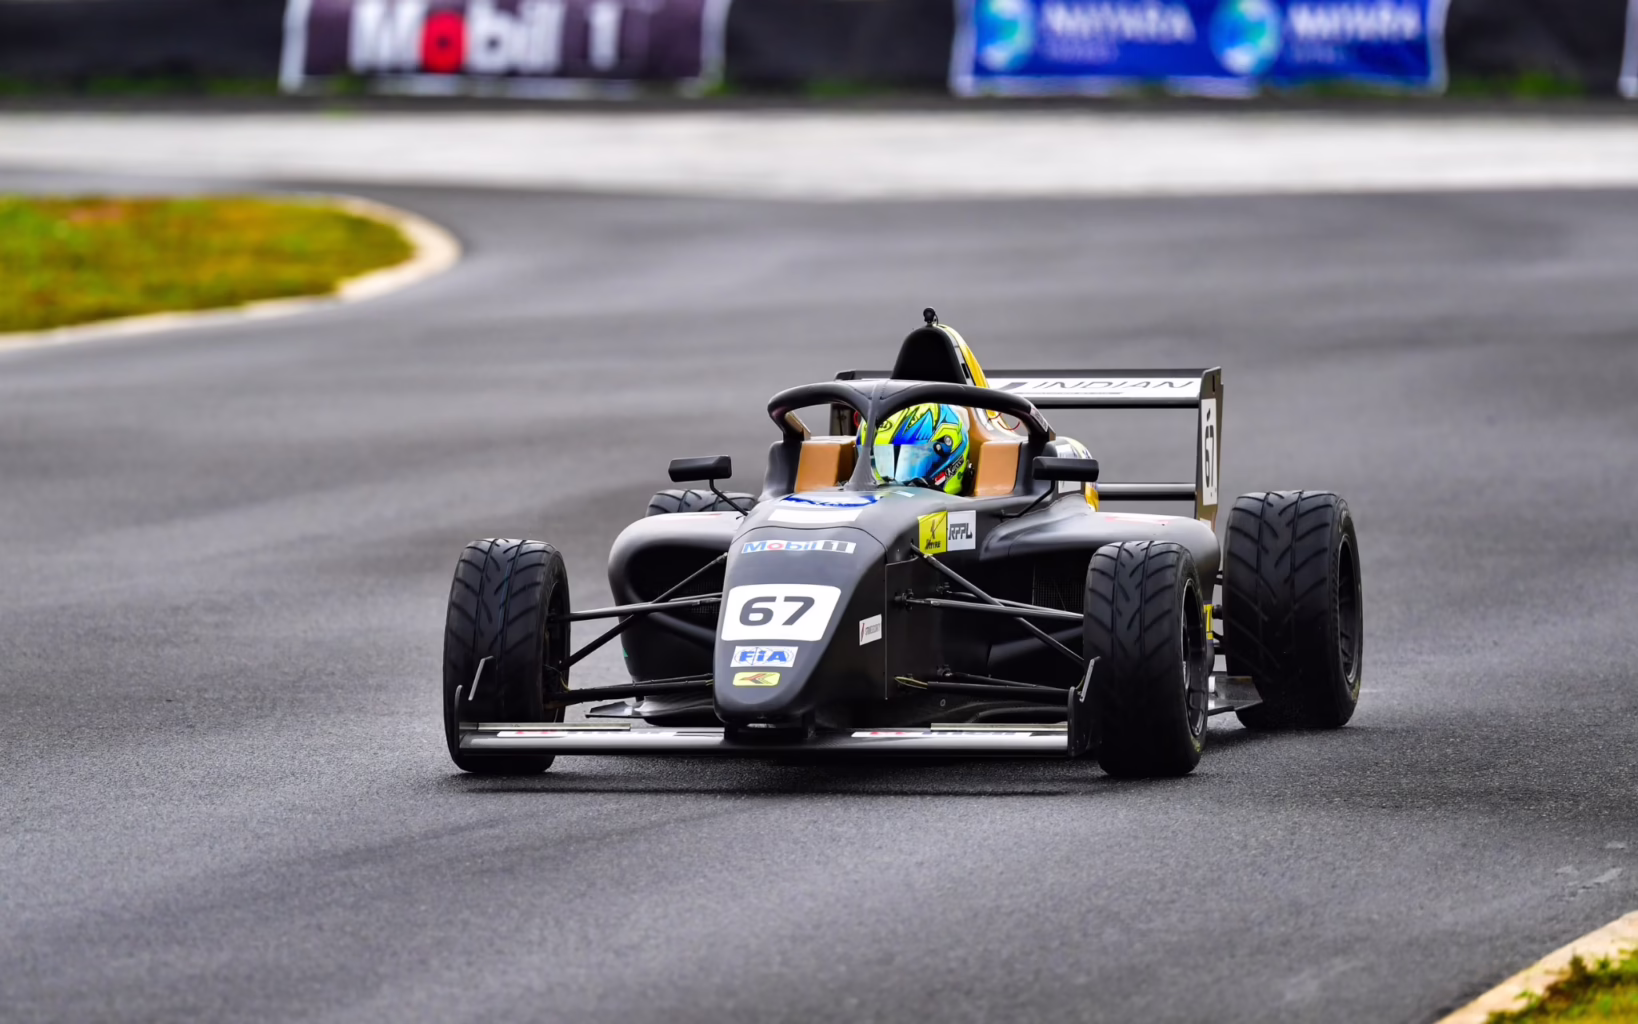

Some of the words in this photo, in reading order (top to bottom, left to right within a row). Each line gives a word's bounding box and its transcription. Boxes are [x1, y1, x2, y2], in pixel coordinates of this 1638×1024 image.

[349, 0, 561, 74] Mobil
[1032, 381, 1193, 389] INDIAN
[948, 523, 973, 540] RPPL
[743, 542, 817, 553] Mobil
[739, 596, 815, 626] 67
